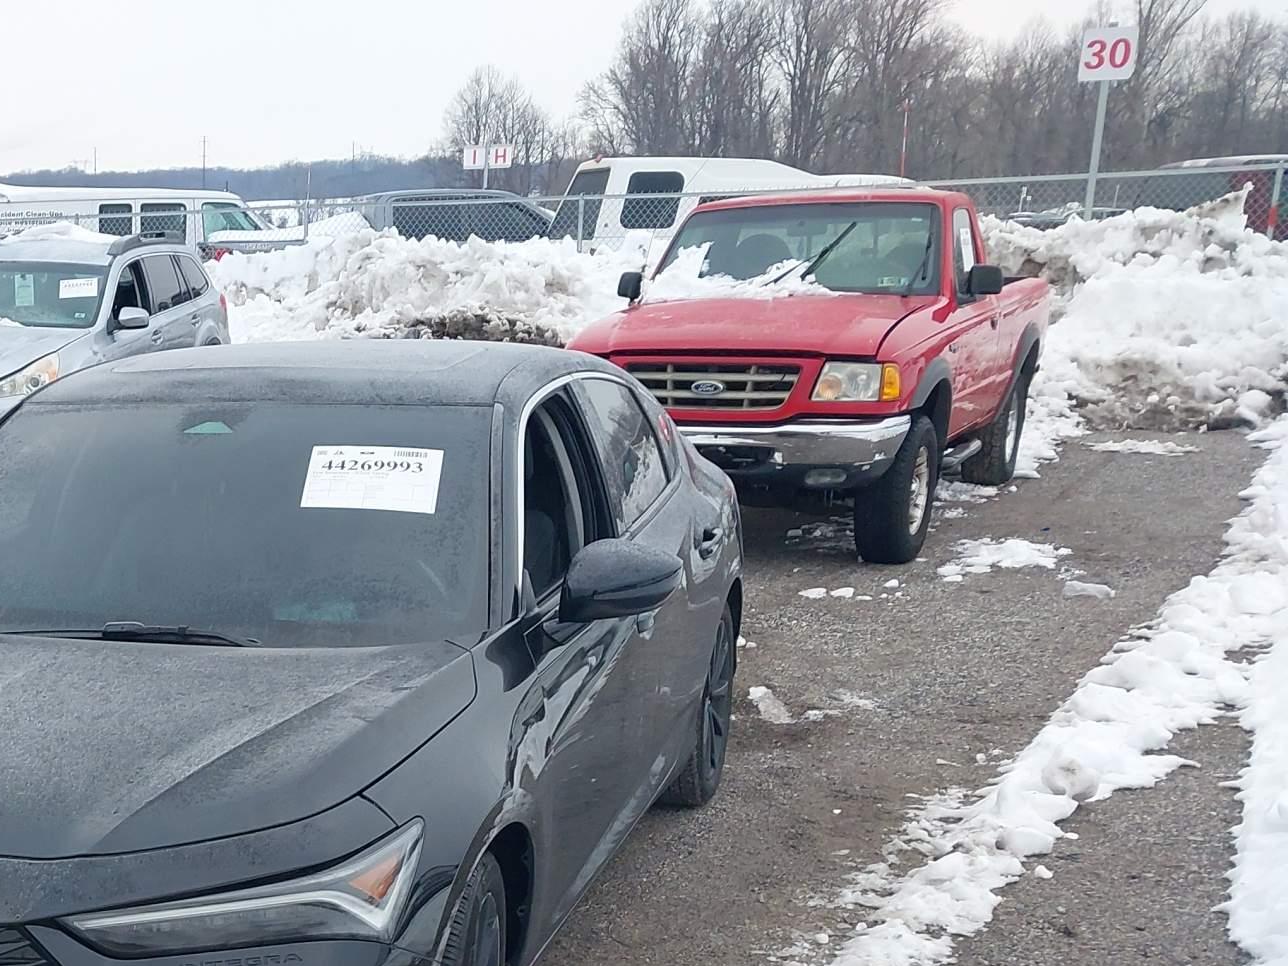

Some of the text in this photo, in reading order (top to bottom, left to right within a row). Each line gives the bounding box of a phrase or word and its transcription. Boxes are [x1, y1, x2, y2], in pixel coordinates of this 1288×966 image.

[1084, 37, 1131, 70] 30
[472, 148, 507, 165] I H
[25, 210, 64, 218] Clean-Ups
[321, 459, 423, 474] 44269993
